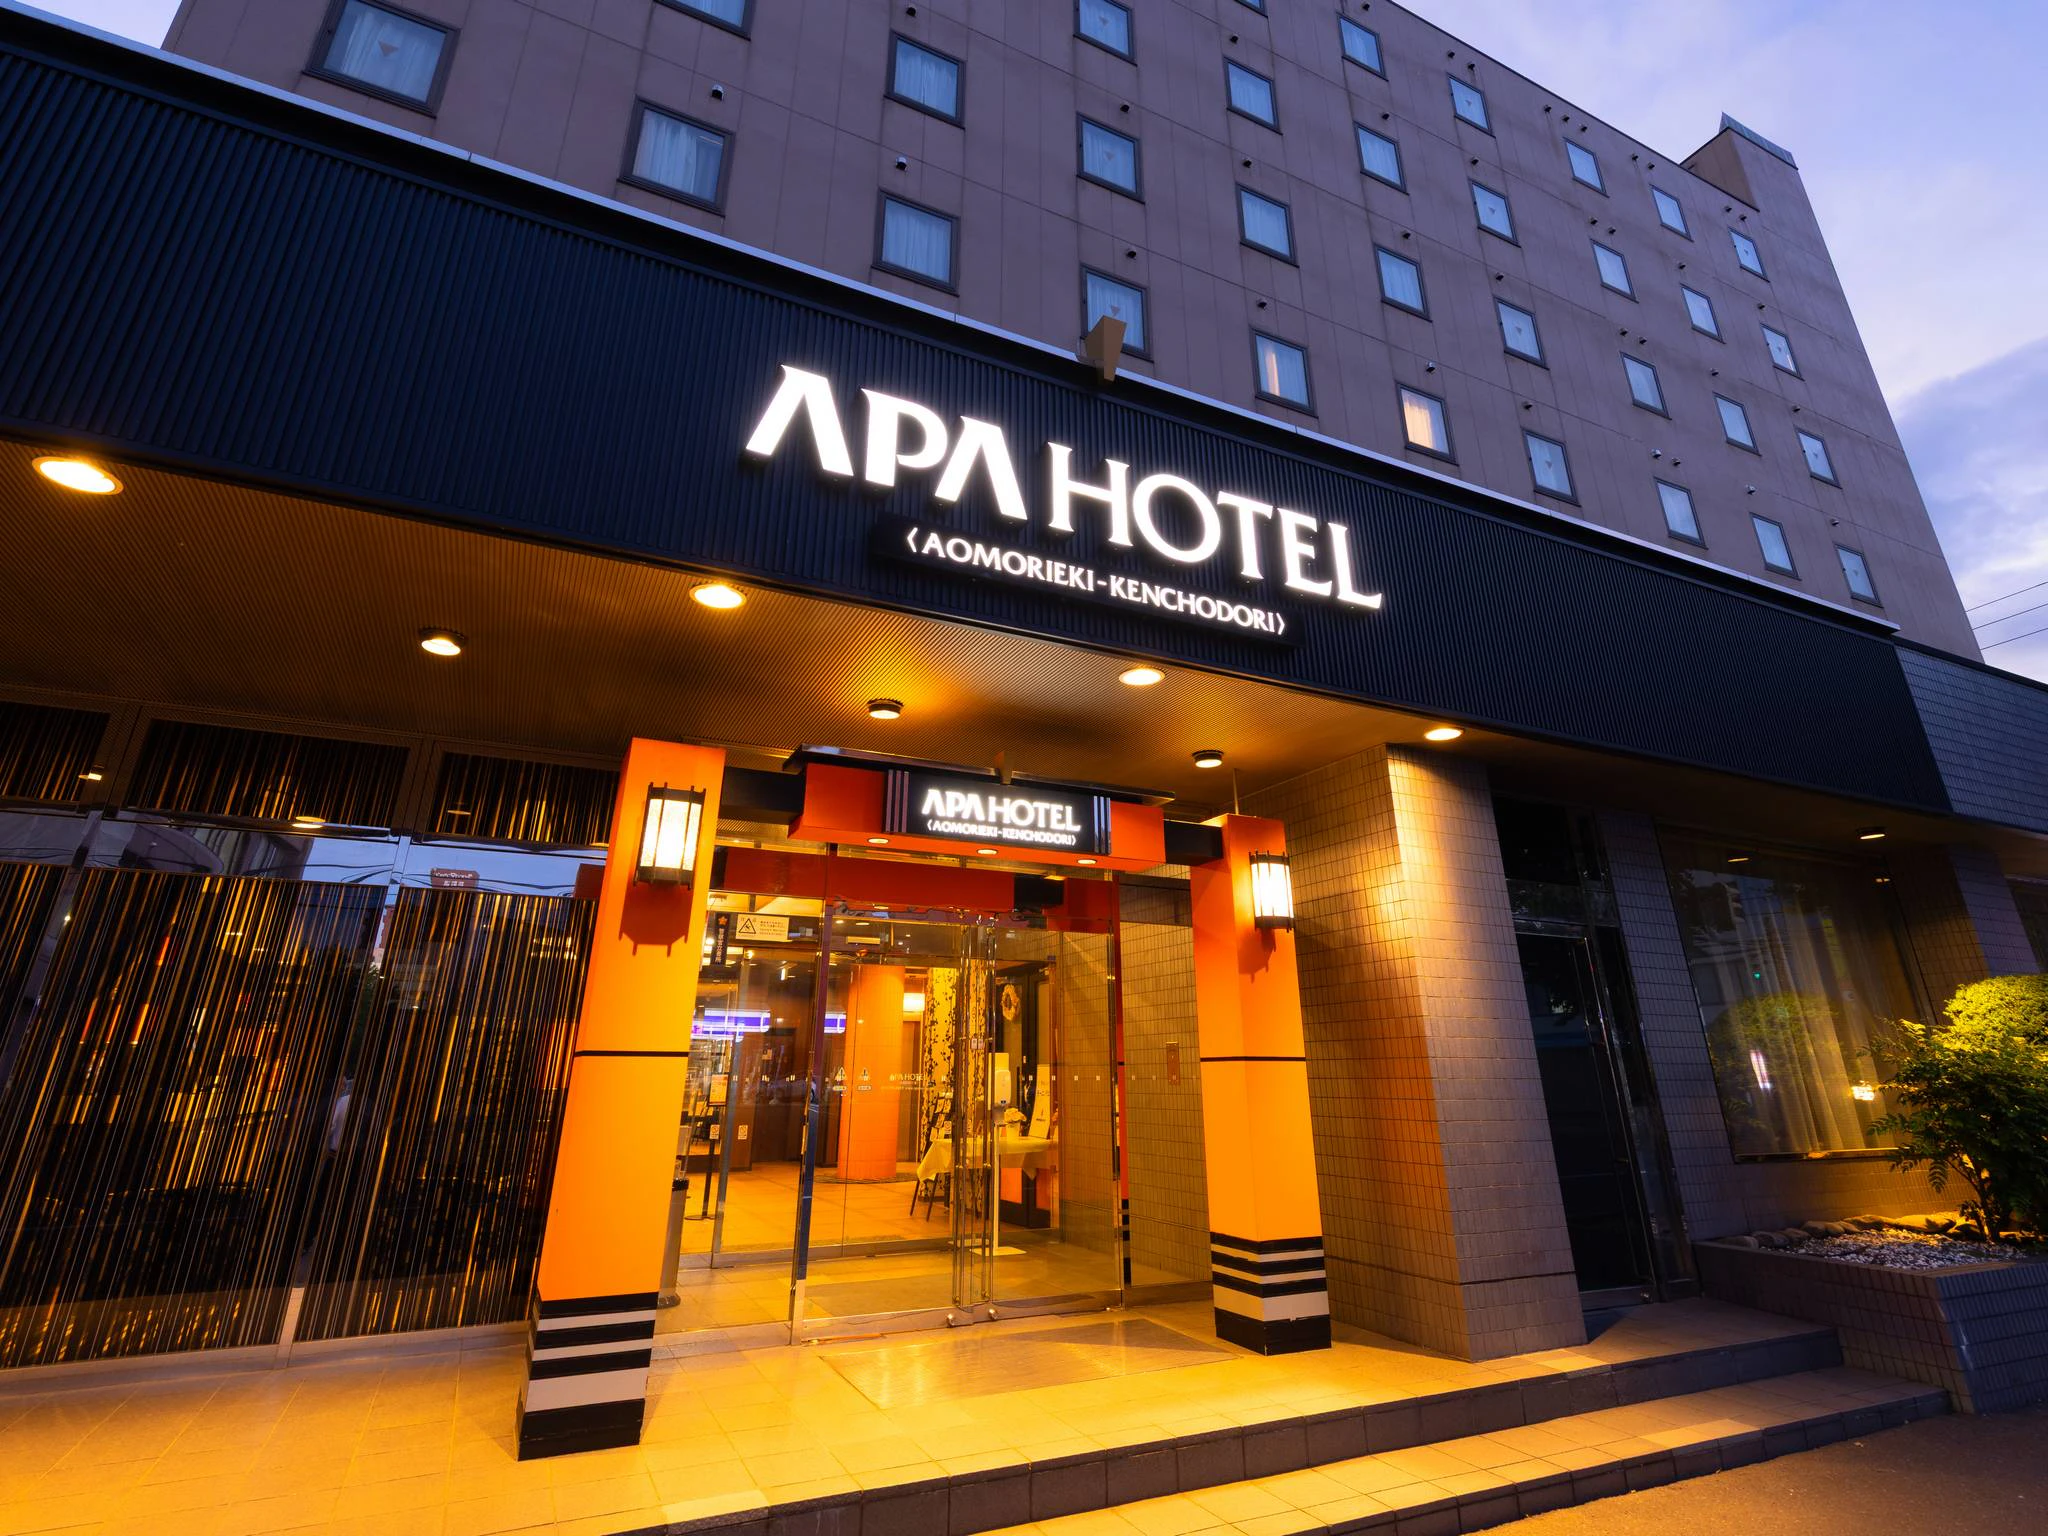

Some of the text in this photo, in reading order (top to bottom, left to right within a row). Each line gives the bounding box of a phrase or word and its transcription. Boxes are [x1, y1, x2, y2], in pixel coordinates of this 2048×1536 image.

[746, 364, 1382, 610] APA HOTEL
[922, 789, 1081, 832] APA HOTEL
